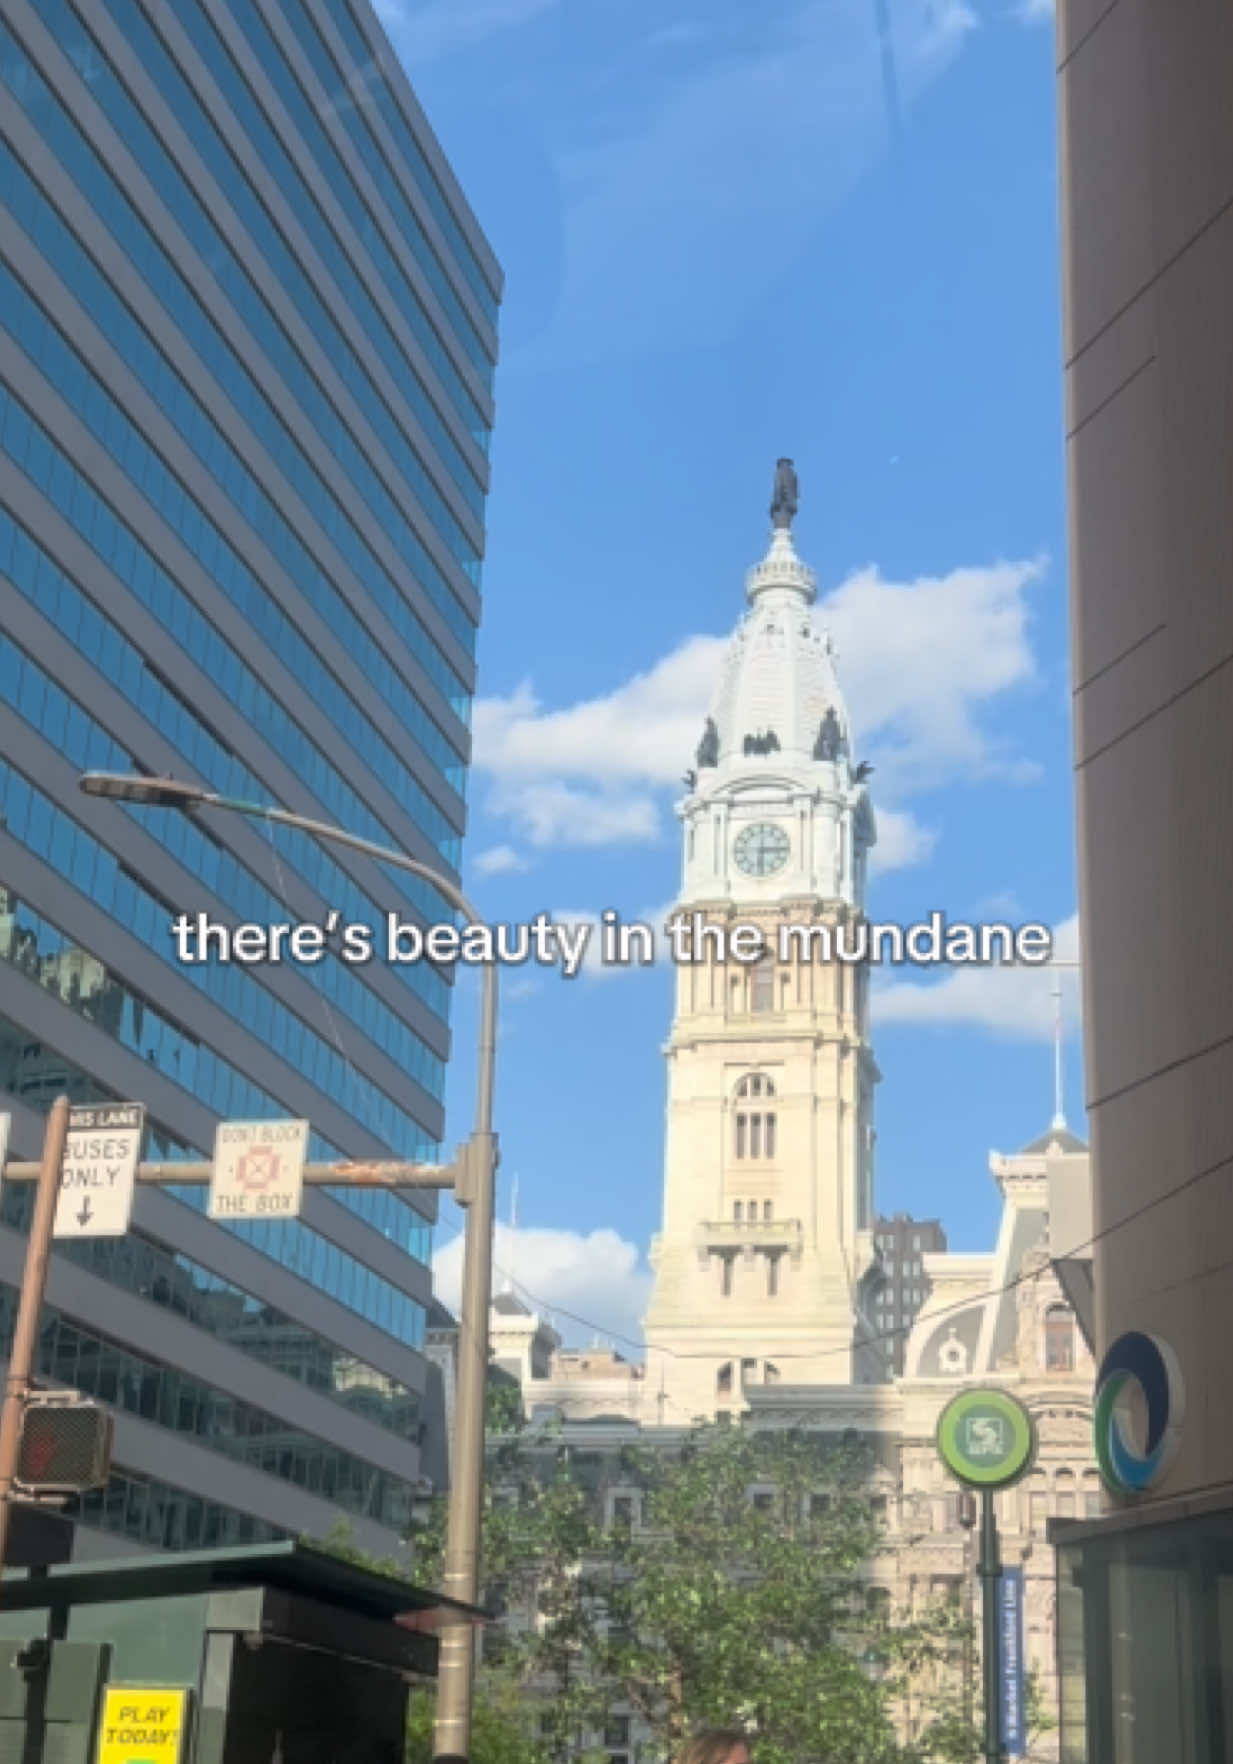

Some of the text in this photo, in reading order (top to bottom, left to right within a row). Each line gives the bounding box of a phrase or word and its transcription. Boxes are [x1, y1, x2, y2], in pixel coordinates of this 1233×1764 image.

[217, 1192, 294, 1213] THE BOX
[119, 1706, 170, 1723] PLAY
